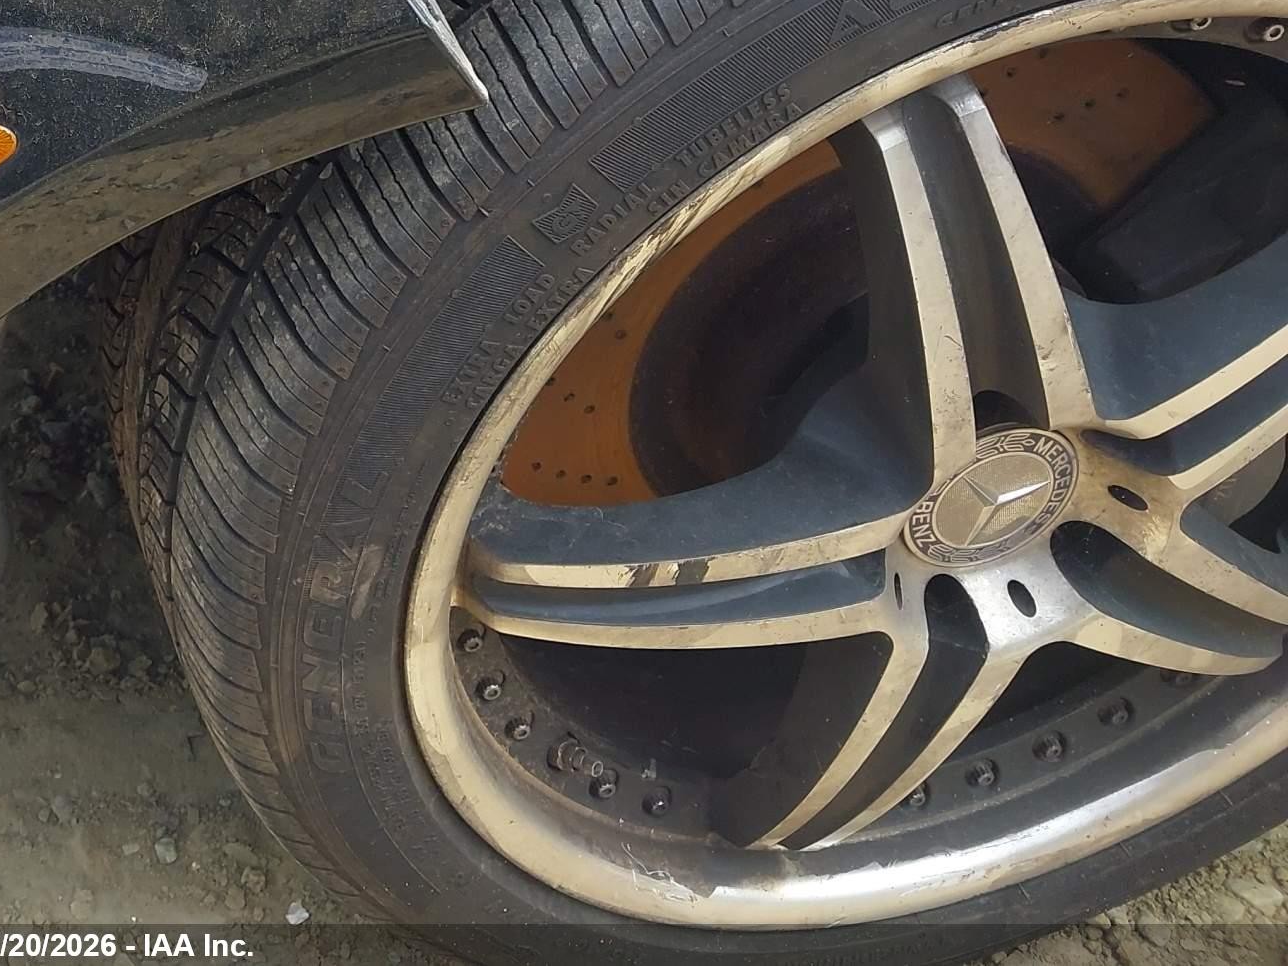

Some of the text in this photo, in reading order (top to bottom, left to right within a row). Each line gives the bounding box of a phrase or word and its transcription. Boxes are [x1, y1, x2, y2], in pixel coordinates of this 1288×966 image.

[569, 81, 793, 258] RADIAL TUBELESS
[646, 101, 805, 219] SIN CAMARA
[443, 272, 557, 405] EXTRA LOAD
[465, 265, 596, 409] CARGA EXTRA
[912, 500, 936, 547] BENZ
[1032, 436, 1071, 524] MERCEDES
[305, 466, 387, 778] GENERAL
